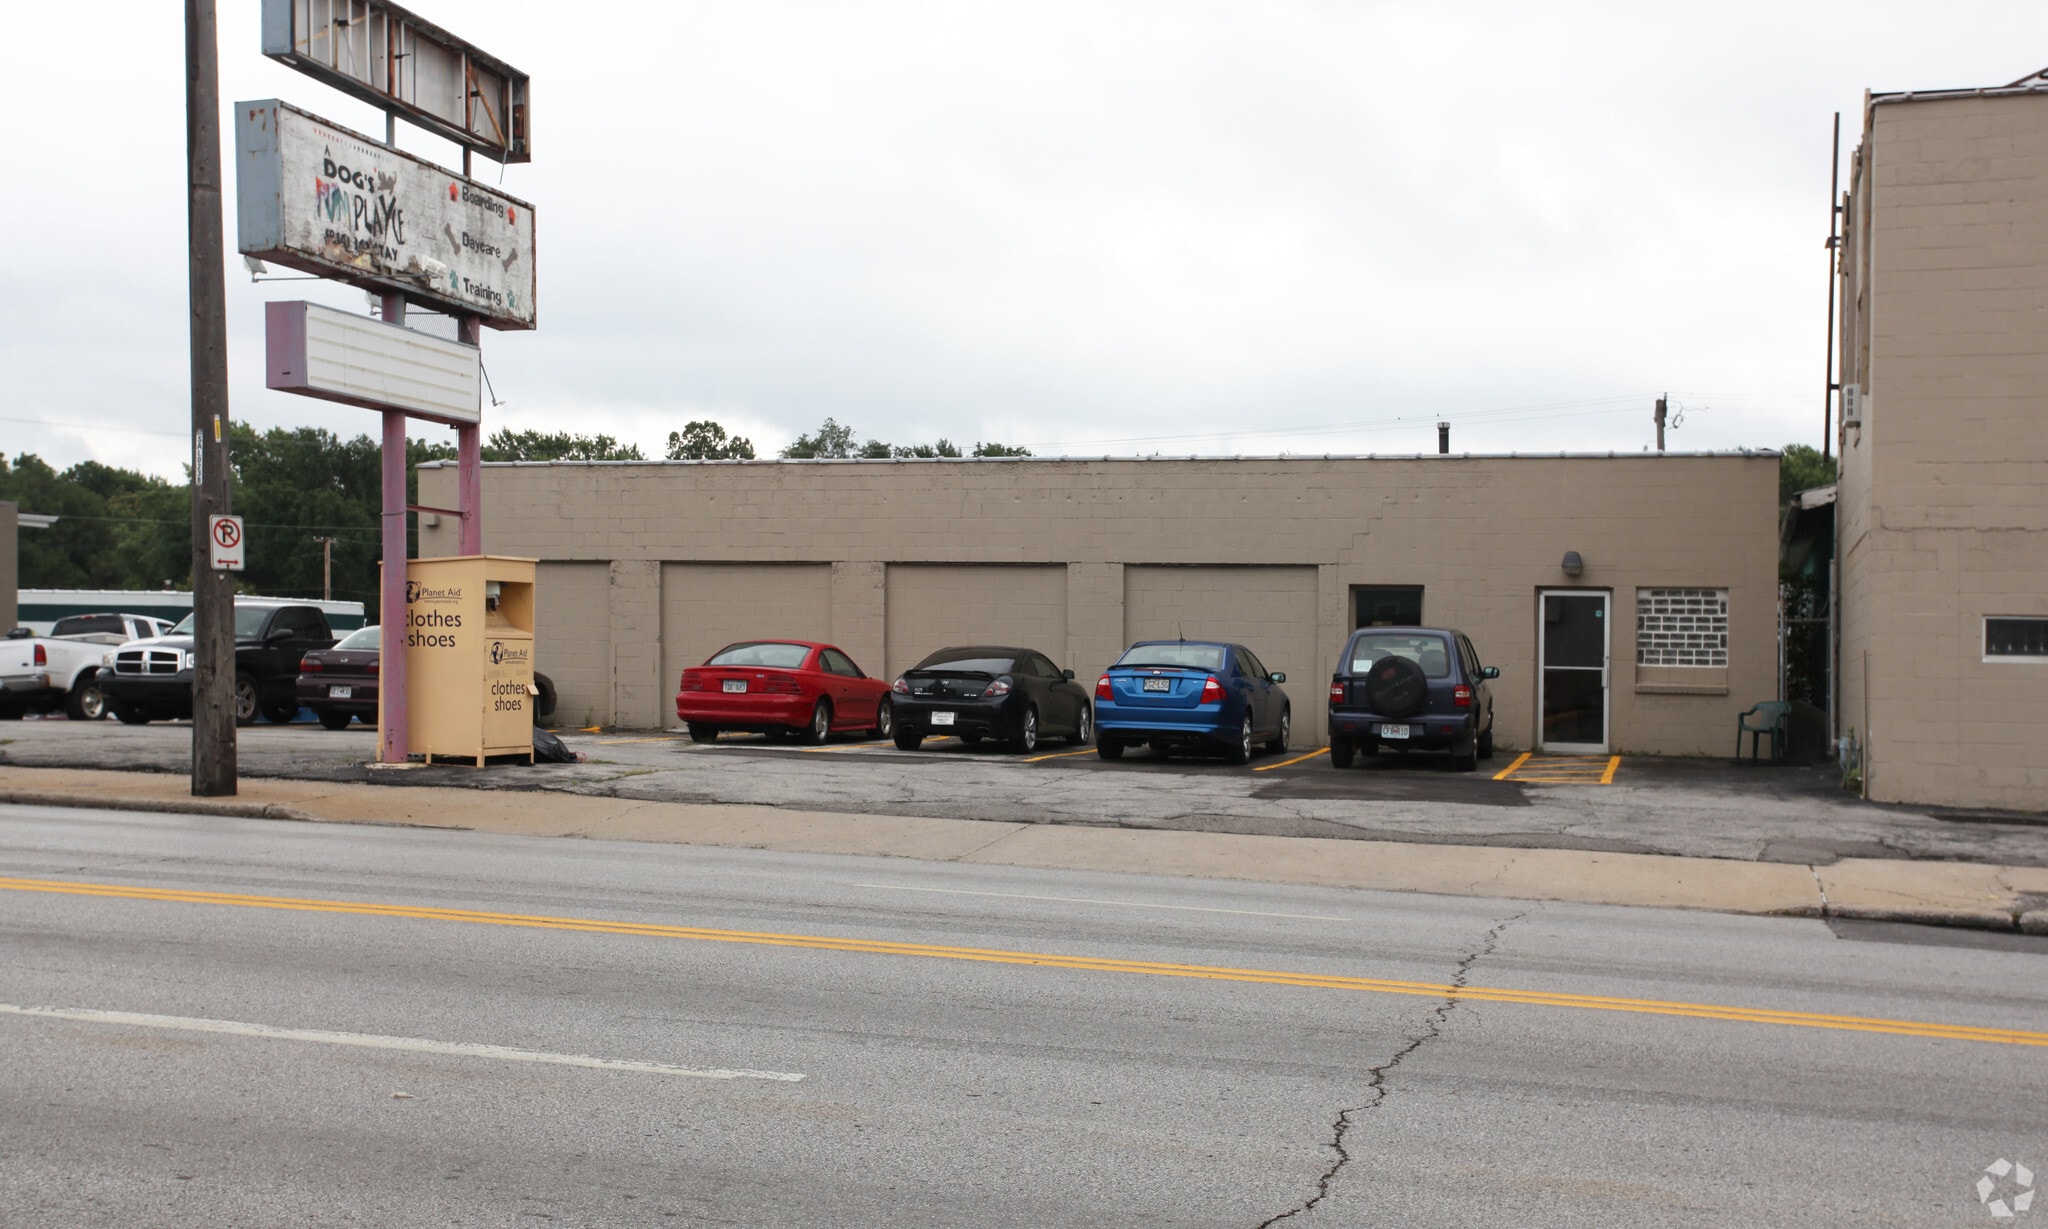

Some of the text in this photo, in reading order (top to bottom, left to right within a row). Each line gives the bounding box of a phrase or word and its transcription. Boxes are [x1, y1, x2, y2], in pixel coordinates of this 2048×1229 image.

[323, 157, 375, 194] DOG'S
[462, 186, 504, 219] Boarding
[354, 194, 405, 245] PLAYCE
[462, 231, 501, 259] Daycare
[463, 277, 502, 306] Training
[421, 587, 462, 597] Planet Aid
[408, 628, 456, 648] shoes
[491, 679, 526, 696] clothes
[494, 695, 522, 712] shoes
